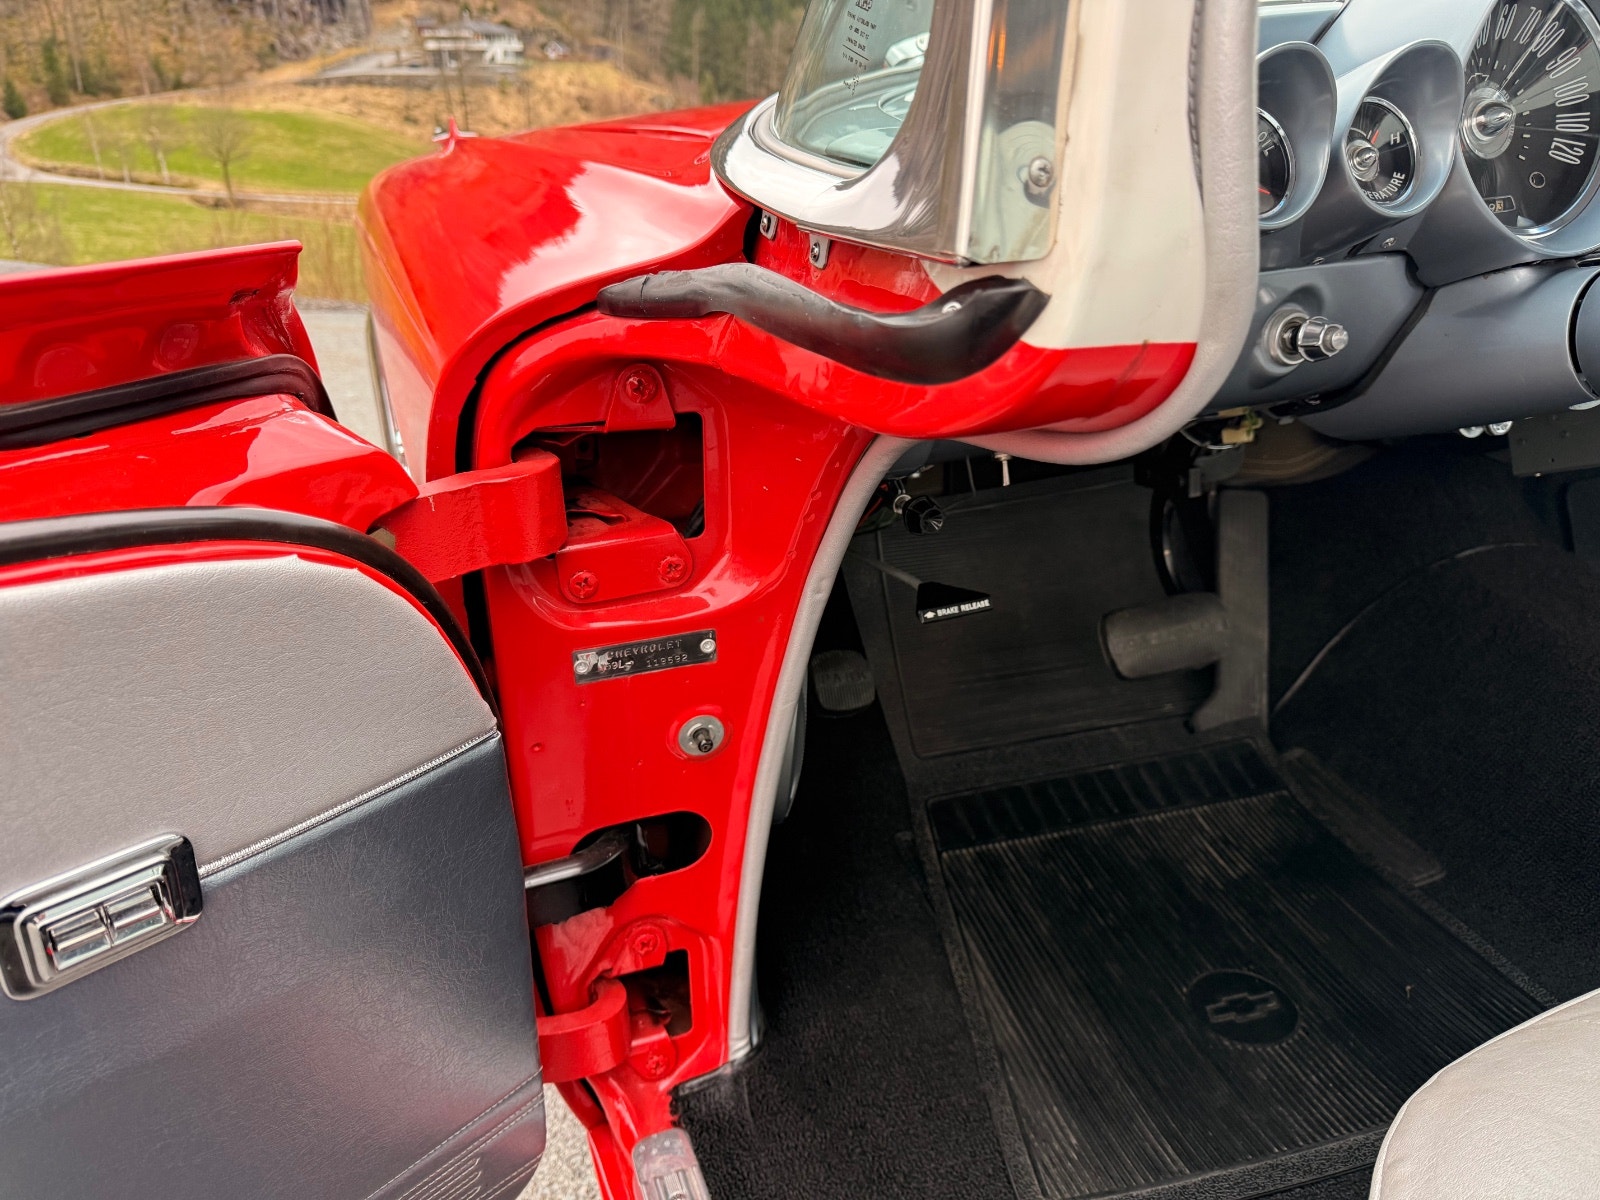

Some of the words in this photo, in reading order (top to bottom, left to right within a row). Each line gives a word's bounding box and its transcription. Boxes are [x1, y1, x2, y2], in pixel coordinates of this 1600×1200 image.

[1495, 3, 1518, 41] 60
[1514, 6, 1542, 45] 70
[1531, 21, 1566, 59] 80
[1545, 46, 1582, 79] 90
[1553, 75, 1590, 108] 100
[1555, 111, 1591, 133] 110
[1257, 131, 1275, 157] OIL
[1390, 132, 1401, 146] H
[1548, 137, 1587, 165] 120
[936, 606, 960, 617] BRAKE
[960, 599, 990, 611] RELEASE
[606, 639, 683, 661] CHEVROLET
[646, 653, 689, 669] 119592
